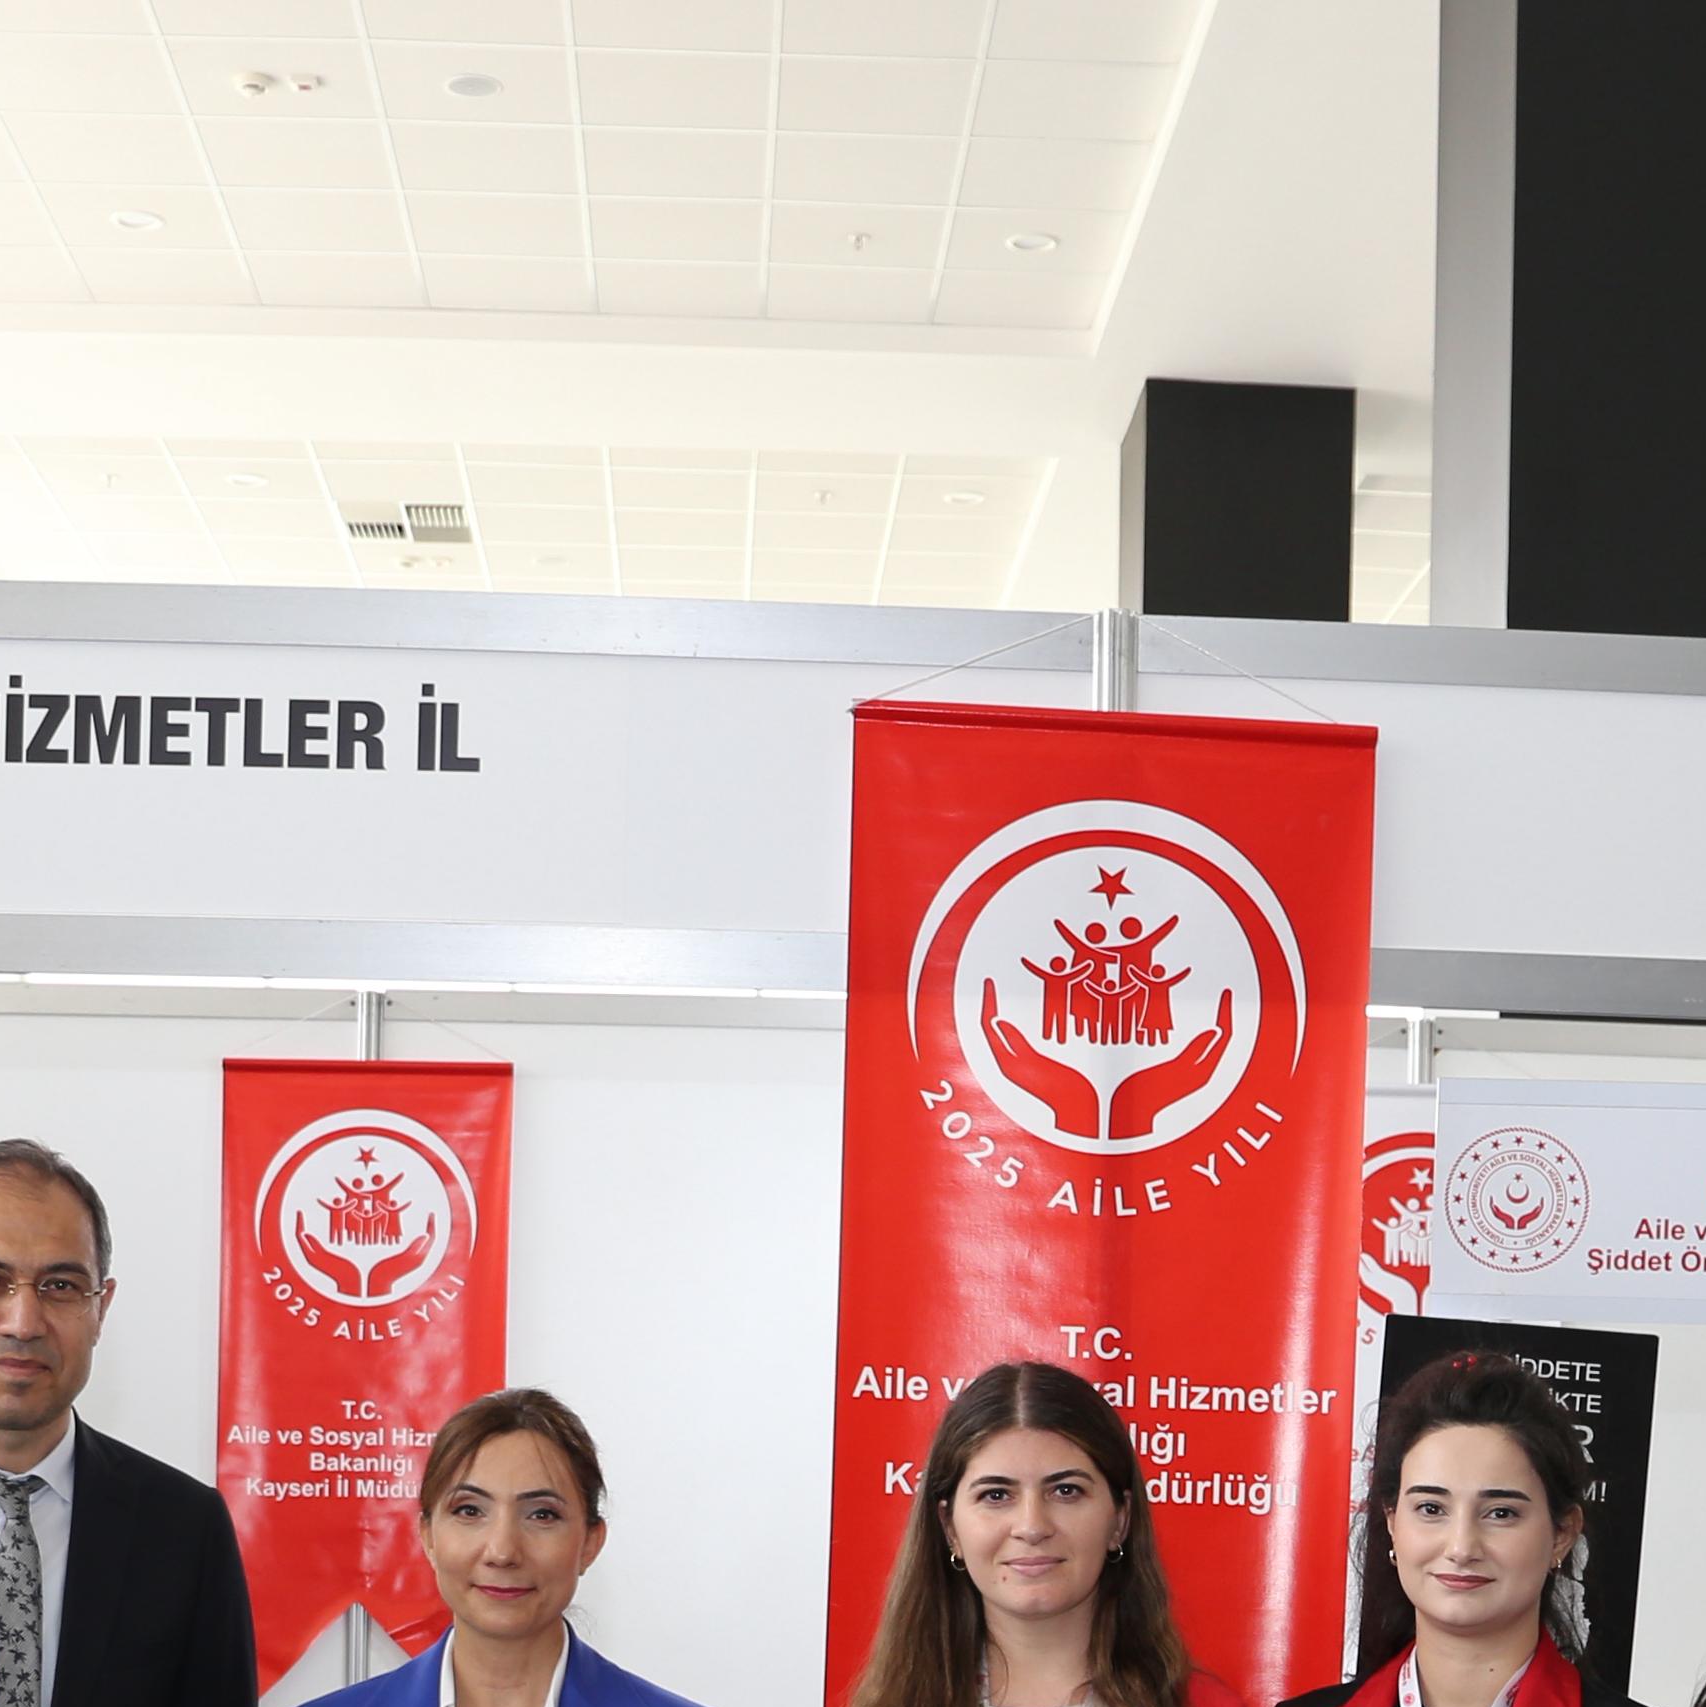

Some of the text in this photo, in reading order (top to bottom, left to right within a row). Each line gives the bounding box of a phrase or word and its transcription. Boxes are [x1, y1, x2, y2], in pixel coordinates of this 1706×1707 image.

[417, 683, 481, 772] İL
[919, 1078, 1285, 1219] 2025 AİLE YILI
[1634, 1218, 1686, 1241] Aile
[1587, 1248, 1673, 1276] Şiddet
[262, 1265, 467, 1344] 2025 AİLE YILI
[1061, 1325, 1133, 1361] T.C.
[853, 1365, 929, 1402] Aile
[941, 1375, 976, 1402] v
[1149, 1376, 1338, 1416] Hizmetler
[341, 1400, 383, 1420] T.C.
[227, 1425, 271, 1445] Aile
[277, 1431, 303, 1445] ve
[309, 1425, 384, 1450] Sosyal
[310, 1452, 413, 1476] Bakanlığı
[246, 1477, 330, 1501] Kayseri
[337, 1474, 349, 1498] İl
